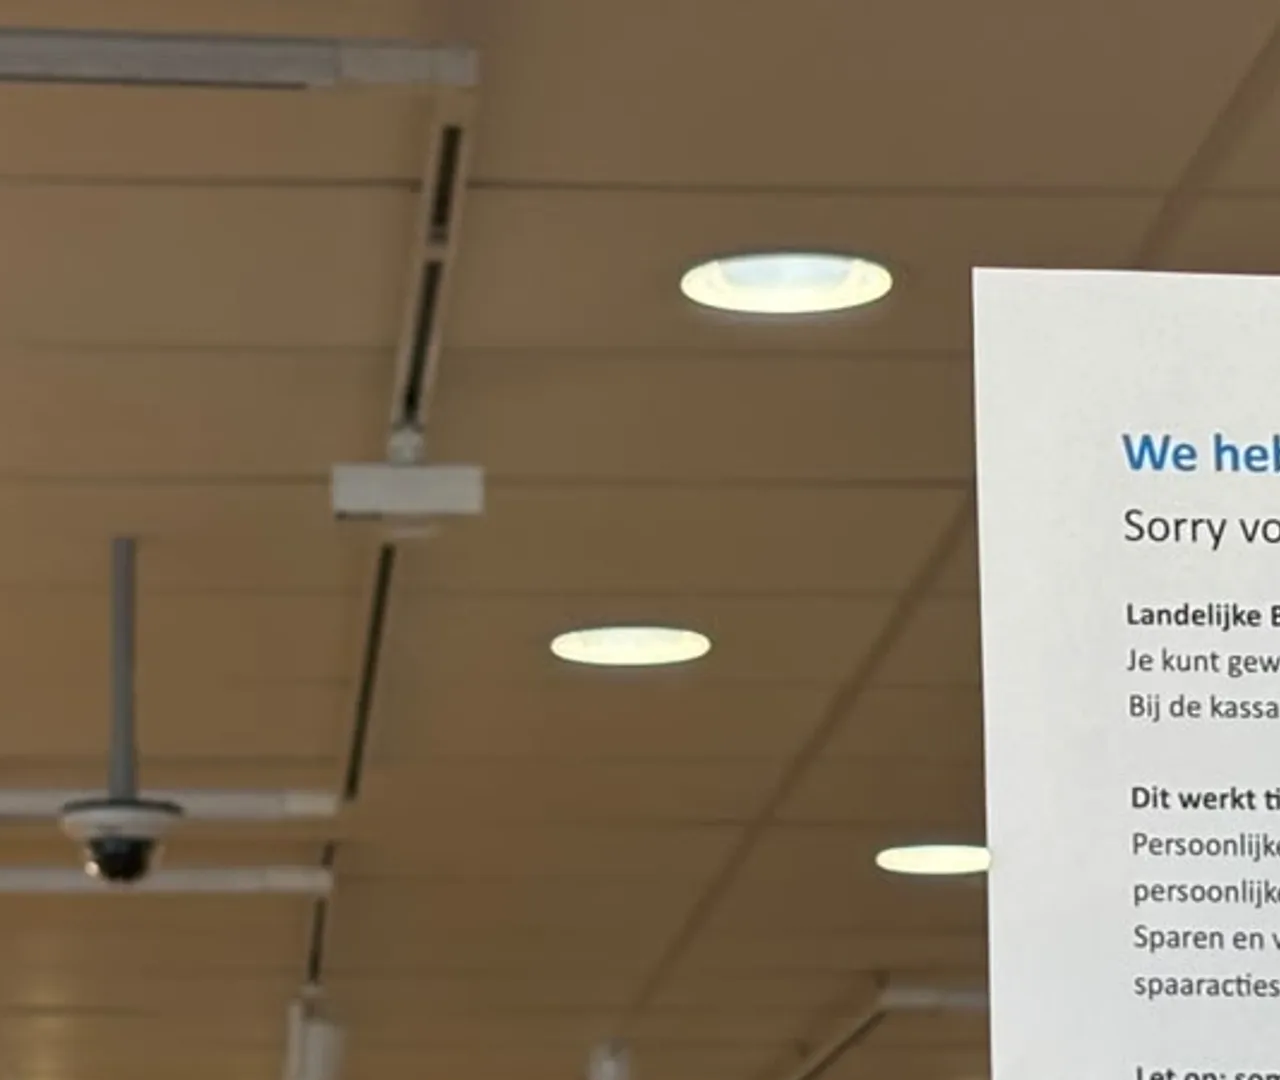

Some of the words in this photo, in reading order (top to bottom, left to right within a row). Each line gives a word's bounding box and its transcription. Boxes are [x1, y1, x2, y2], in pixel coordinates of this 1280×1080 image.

[1121, 433, 1198, 473] We
[1124, 508, 1228, 552] Sorry
[1126, 602, 1263, 633] Landelijke
[1126, 648, 1155, 673] Je
[1161, 647, 1221, 674] kunt
[1129, 693, 1161, 724] Bij
[1168, 693, 1202, 719] de
[1209, 693, 1280, 720] kassa
[1131, 785, 1171, 811] Dit
[1177, 785, 1257, 811] werkt
[1133, 924, 1225, 954] Sparen
[1232, 931, 1265, 951] en
